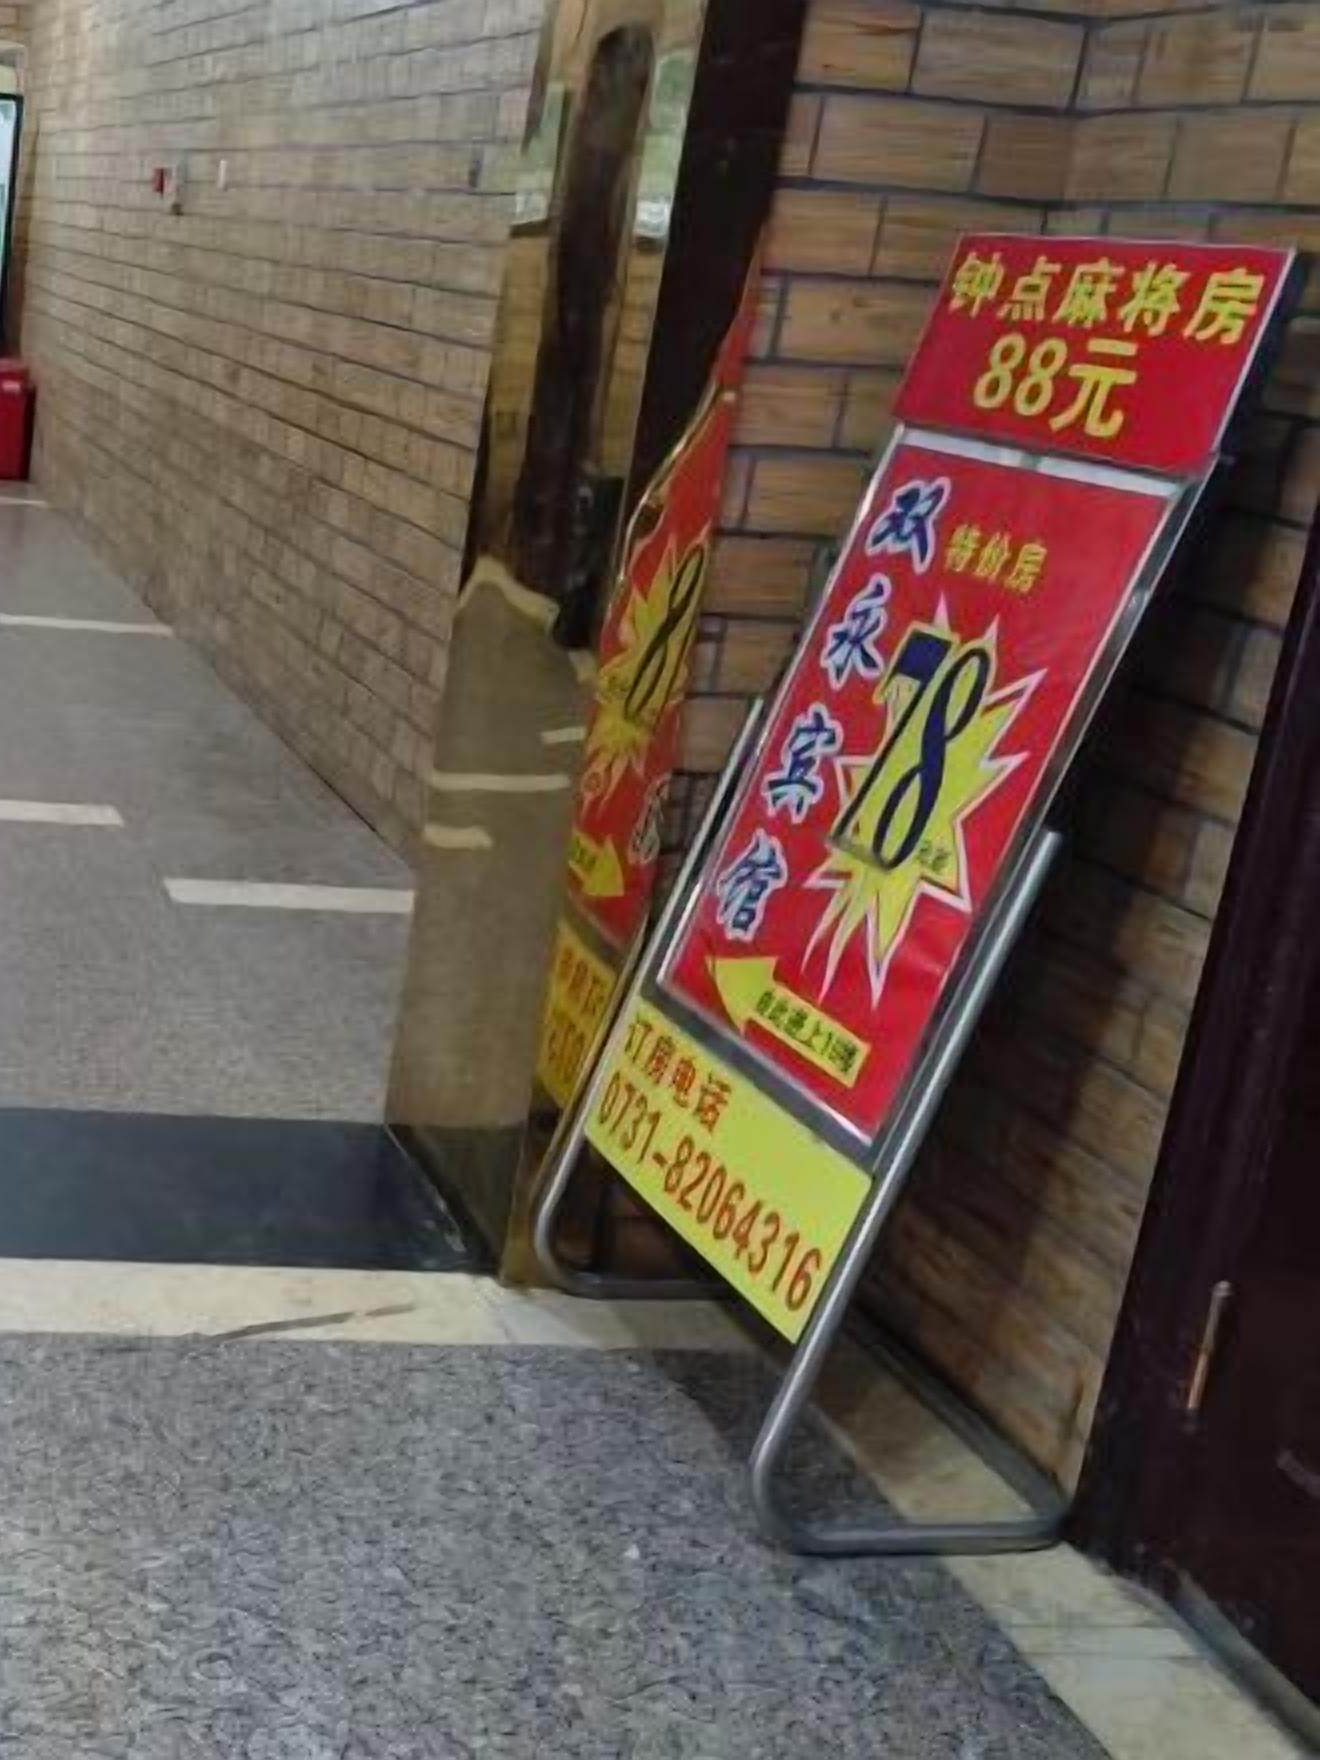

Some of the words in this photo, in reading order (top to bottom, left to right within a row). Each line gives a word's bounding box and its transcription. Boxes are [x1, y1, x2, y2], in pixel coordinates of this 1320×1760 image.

[948, 252, 1266, 345] 钟点麻将房
[972, 332, 1139, 438] 88元
[944, 523, 1048, 594] 特价房
[830, 630, 991, 871] 78
[624, 1017, 733, 1135] 订房电话
[597, 1070, 824, 1313] 0731-82064316
